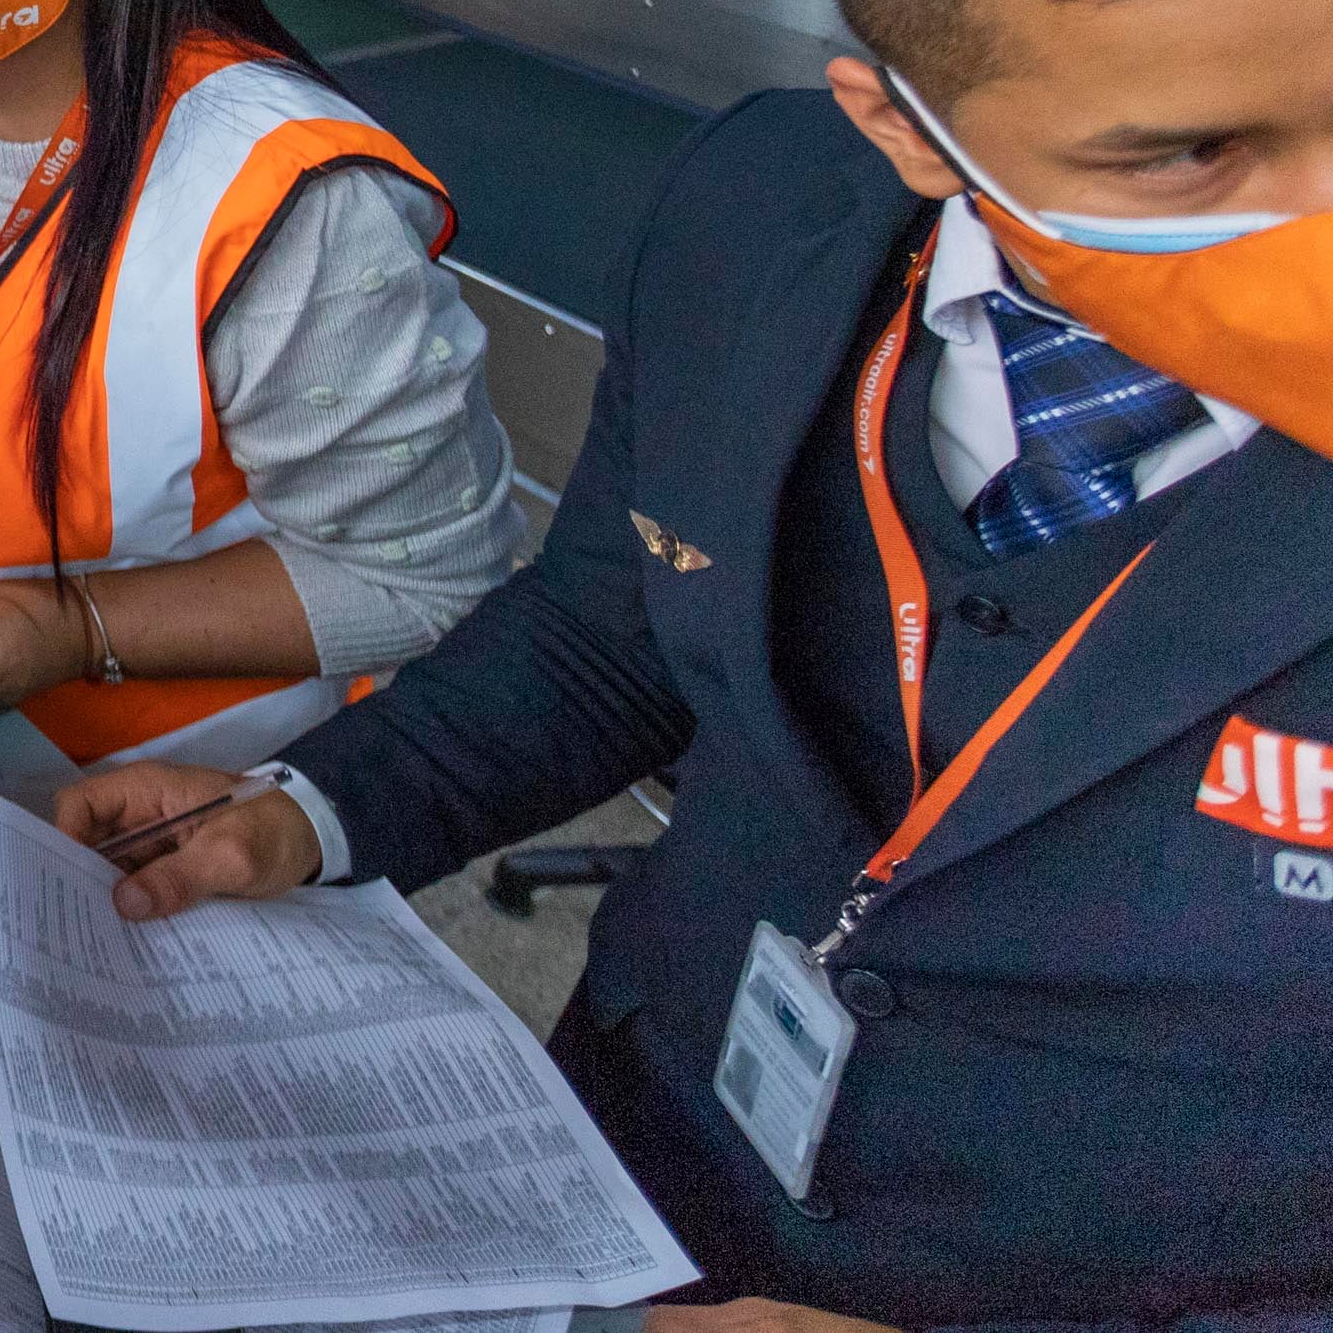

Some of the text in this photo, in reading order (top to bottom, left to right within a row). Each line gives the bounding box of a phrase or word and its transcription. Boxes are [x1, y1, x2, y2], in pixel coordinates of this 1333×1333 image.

[40, 137, 78, 186] ultra
[859, 332, 899, 454] ultraair.com
[897, 602, 919, 683] ultra
